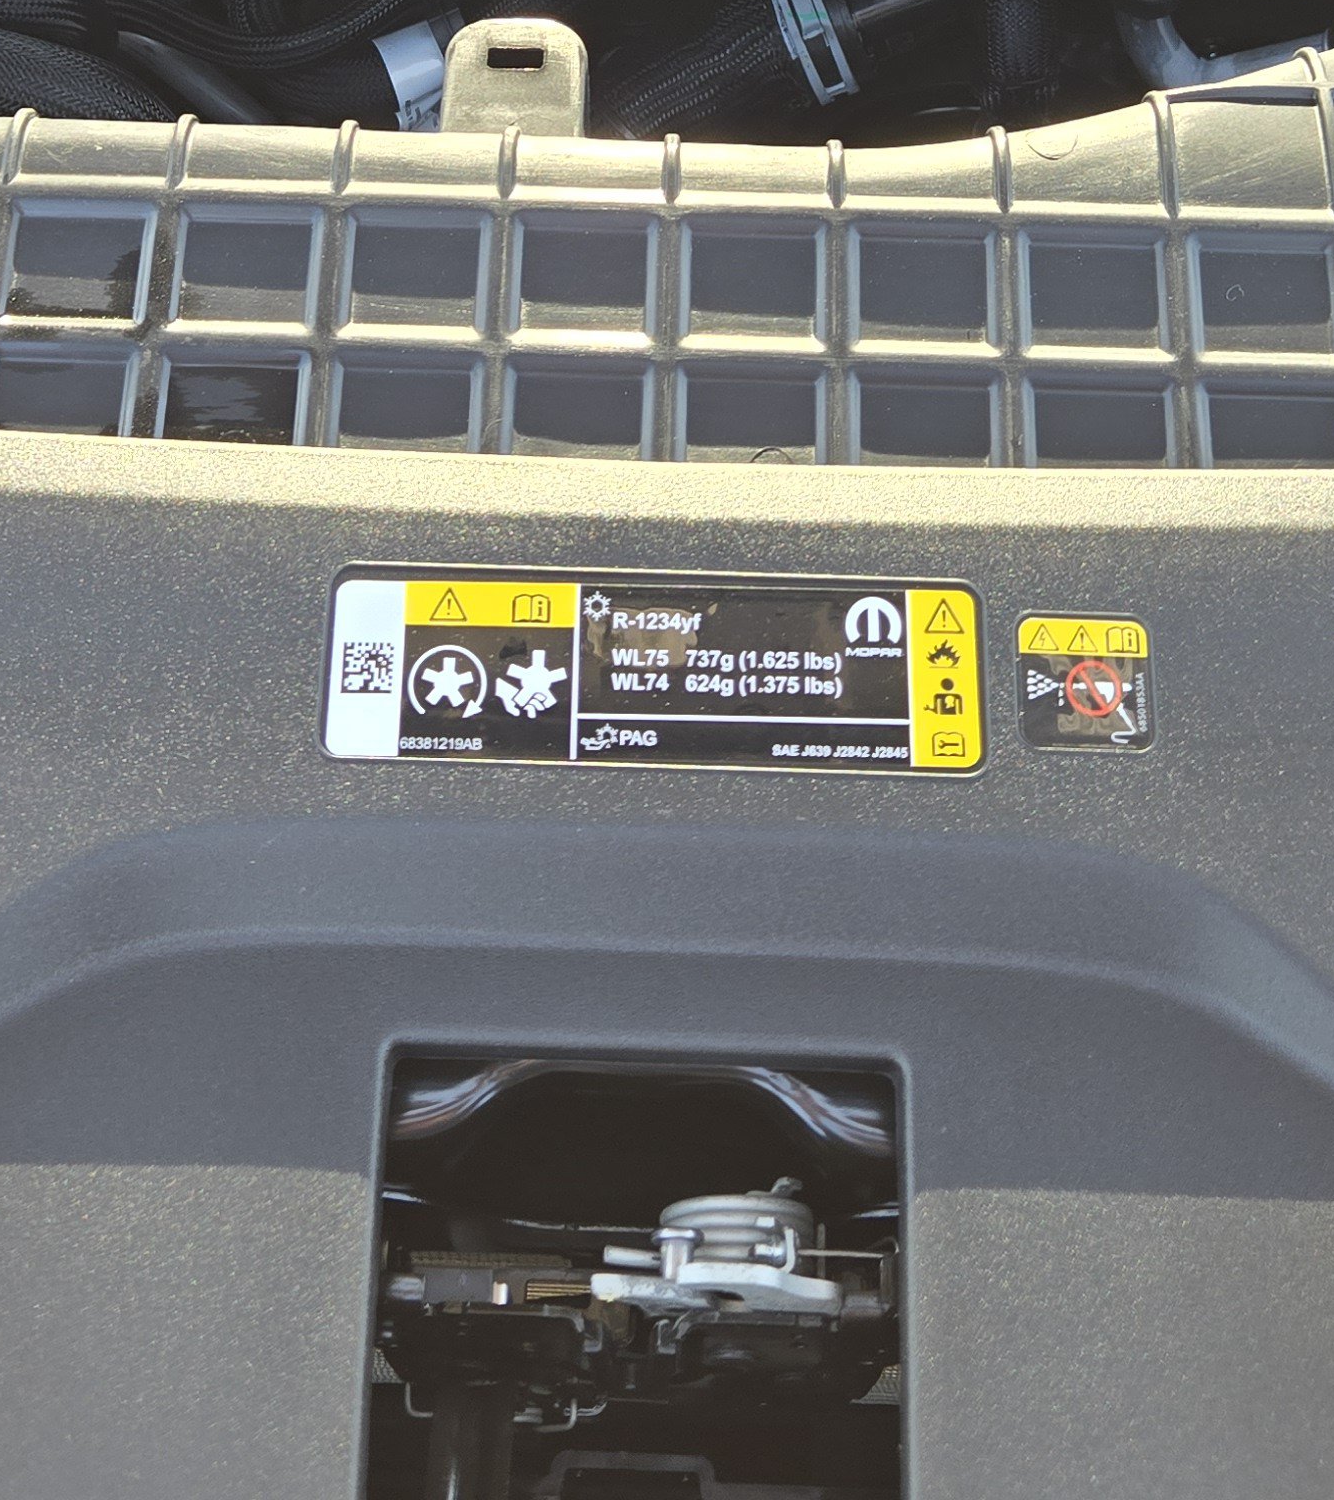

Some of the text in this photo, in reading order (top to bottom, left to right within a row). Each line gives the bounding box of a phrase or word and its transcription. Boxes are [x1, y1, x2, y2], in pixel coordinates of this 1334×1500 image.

[612, 612, 702, 635] R-1234yf
[844, 646, 905, 658] MOPAR
[611, 648, 842, 675] WL75 737g (1.625 lbs)
[611, 672, 843, 699] WL74 624g (1.375 lbs)
[399, 735, 483, 751] 68381219AB
[619, 729, 658, 747] PAG
[771, 743, 800, 757] SAE
[800, 744, 832, 758] J639
